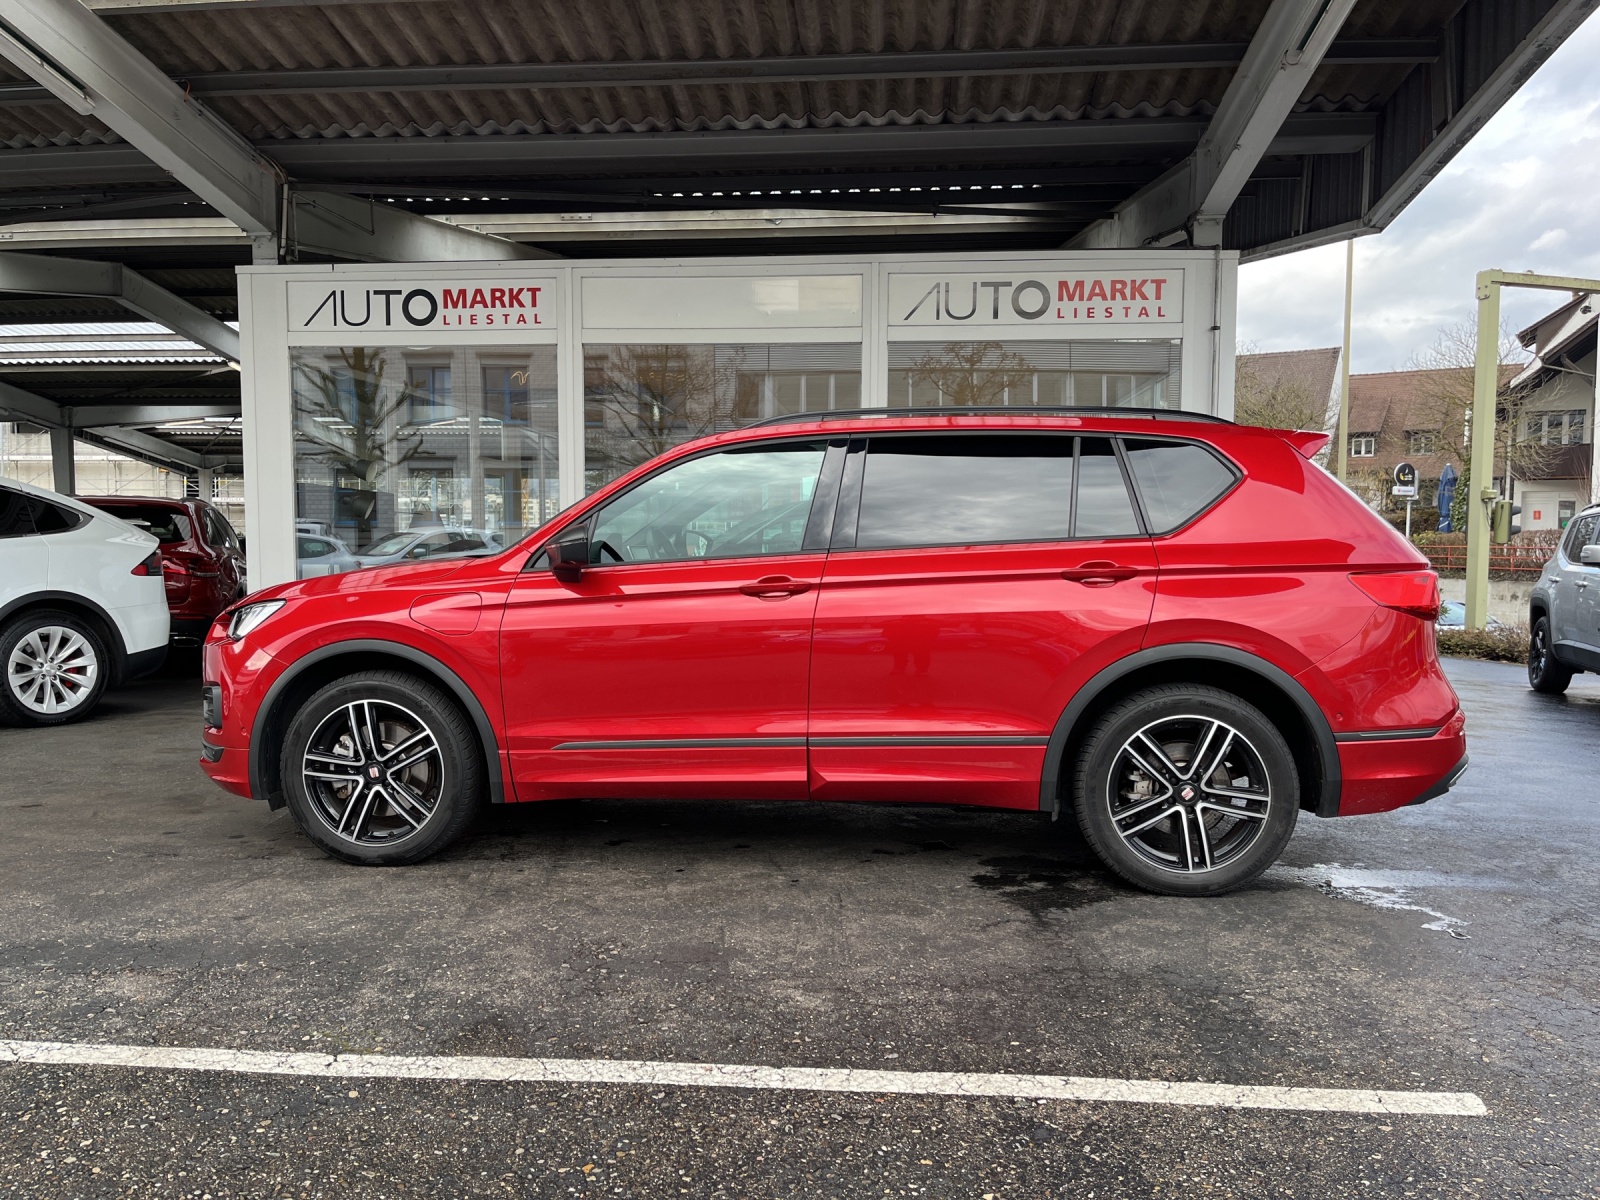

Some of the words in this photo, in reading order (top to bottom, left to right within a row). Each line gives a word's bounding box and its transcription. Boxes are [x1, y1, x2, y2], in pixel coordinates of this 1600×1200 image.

[304, 288, 438, 327] AUTO
[443, 286, 541, 309] MARKT
[904, 280, 1051, 320] AUTO
[1057, 279, 1166, 302] MARKT
[1057, 306, 1165, 319] LIESTAL
[443, 313, 541, 326] LIESTAL
